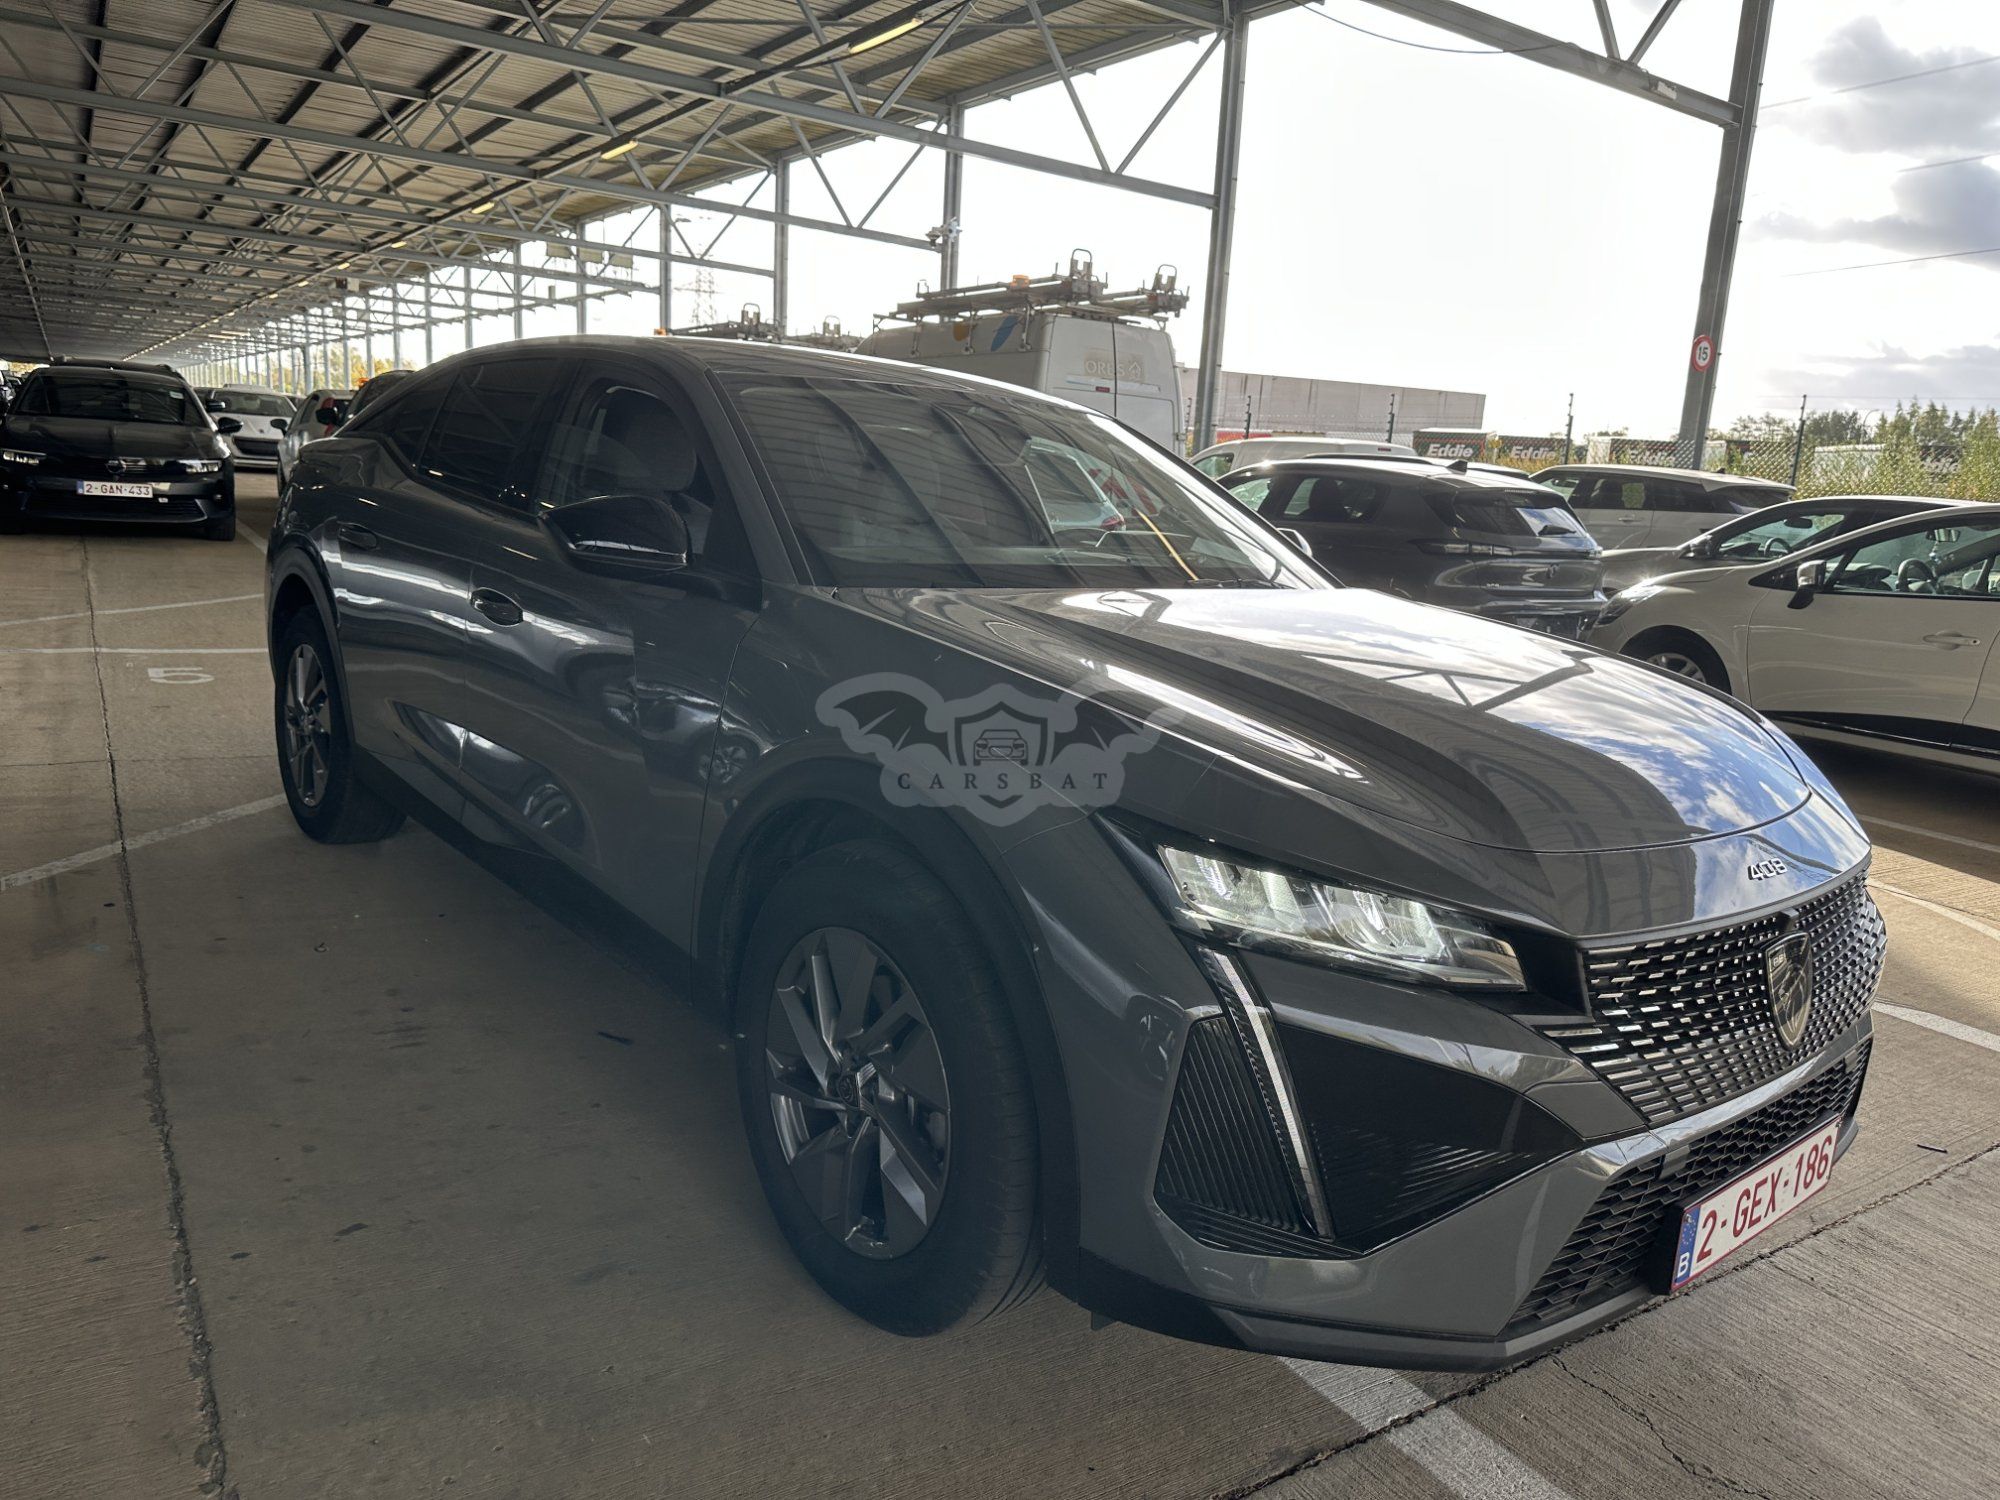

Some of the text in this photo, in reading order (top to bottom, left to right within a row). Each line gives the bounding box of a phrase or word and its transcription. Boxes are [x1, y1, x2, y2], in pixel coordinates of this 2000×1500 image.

[1698, 346, 1709, 361] 15
[1427, 443, 1474, 458] Eddie
[1511, 445, 1556, 460] Eddie
[85, 483, 150, 496] 2-GAN-433
[147, 667, 215, 684] 5
[1748, 858, 1787, 880] 408
[1696, 1135, 1832, 1264] 2-GEX-186
[1677, 1252, 1690, 1278] B
